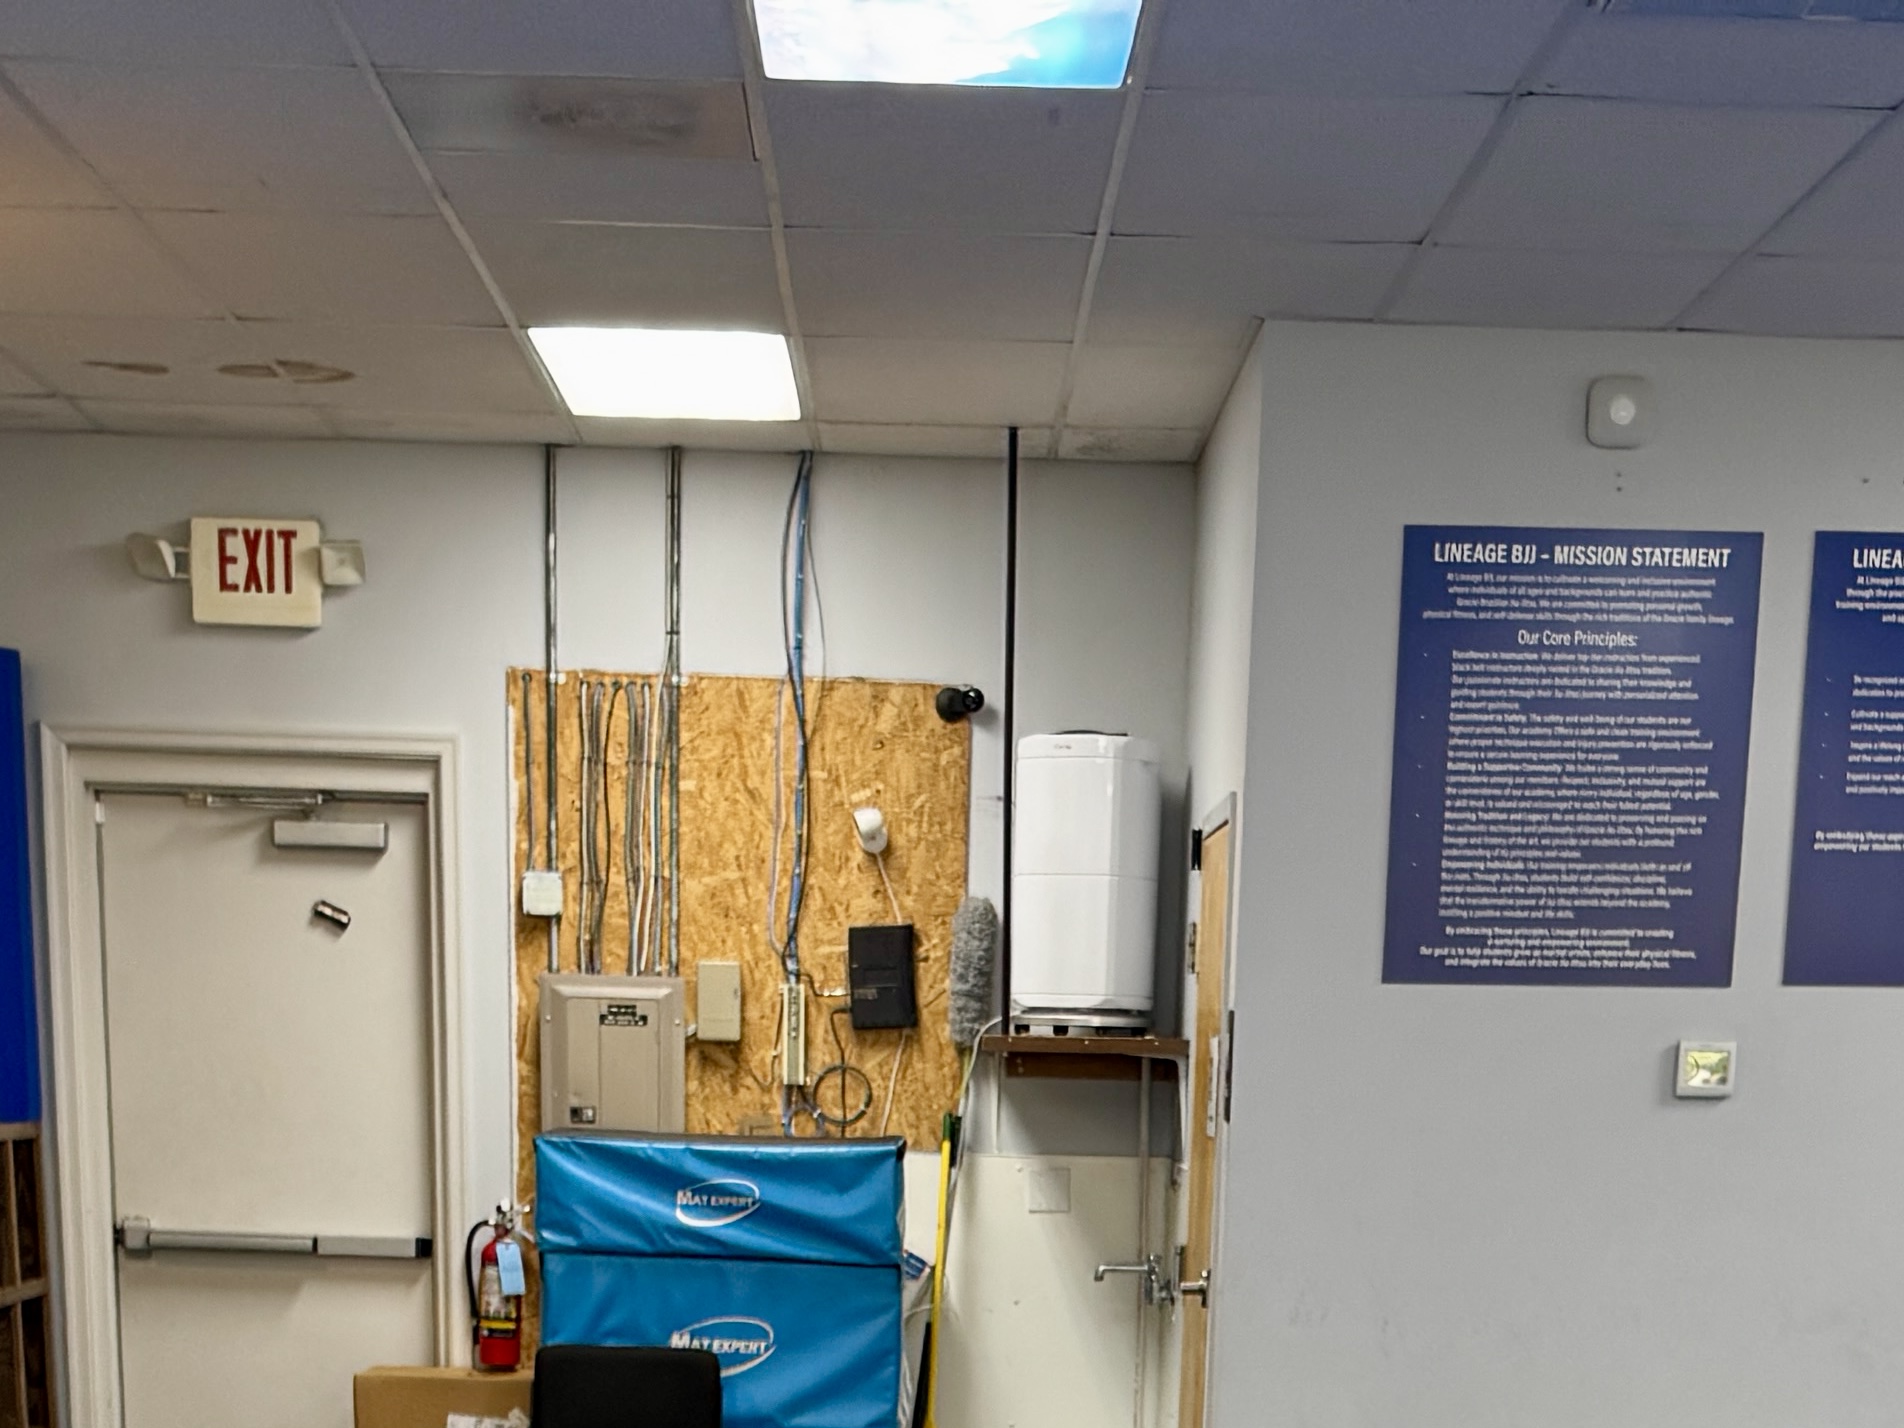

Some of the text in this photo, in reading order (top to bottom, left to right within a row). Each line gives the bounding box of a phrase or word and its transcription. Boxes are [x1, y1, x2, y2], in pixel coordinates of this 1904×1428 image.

[217, 527, 298, 595] EXIT
[1434, 542, 1507, 564] LINEAGE
[1511, 544, 1535, 565] BJJ
[1554, 545, 1627, 566] MISSION
[1631, 547, 1731, 568] STATEMENT
[1518, 629, 1638, 649] Our Core Principles:
[677, 1190, 753, 1208] MAT EXPERT
[670, 1331, 768, 1355] MAT EXPERT
